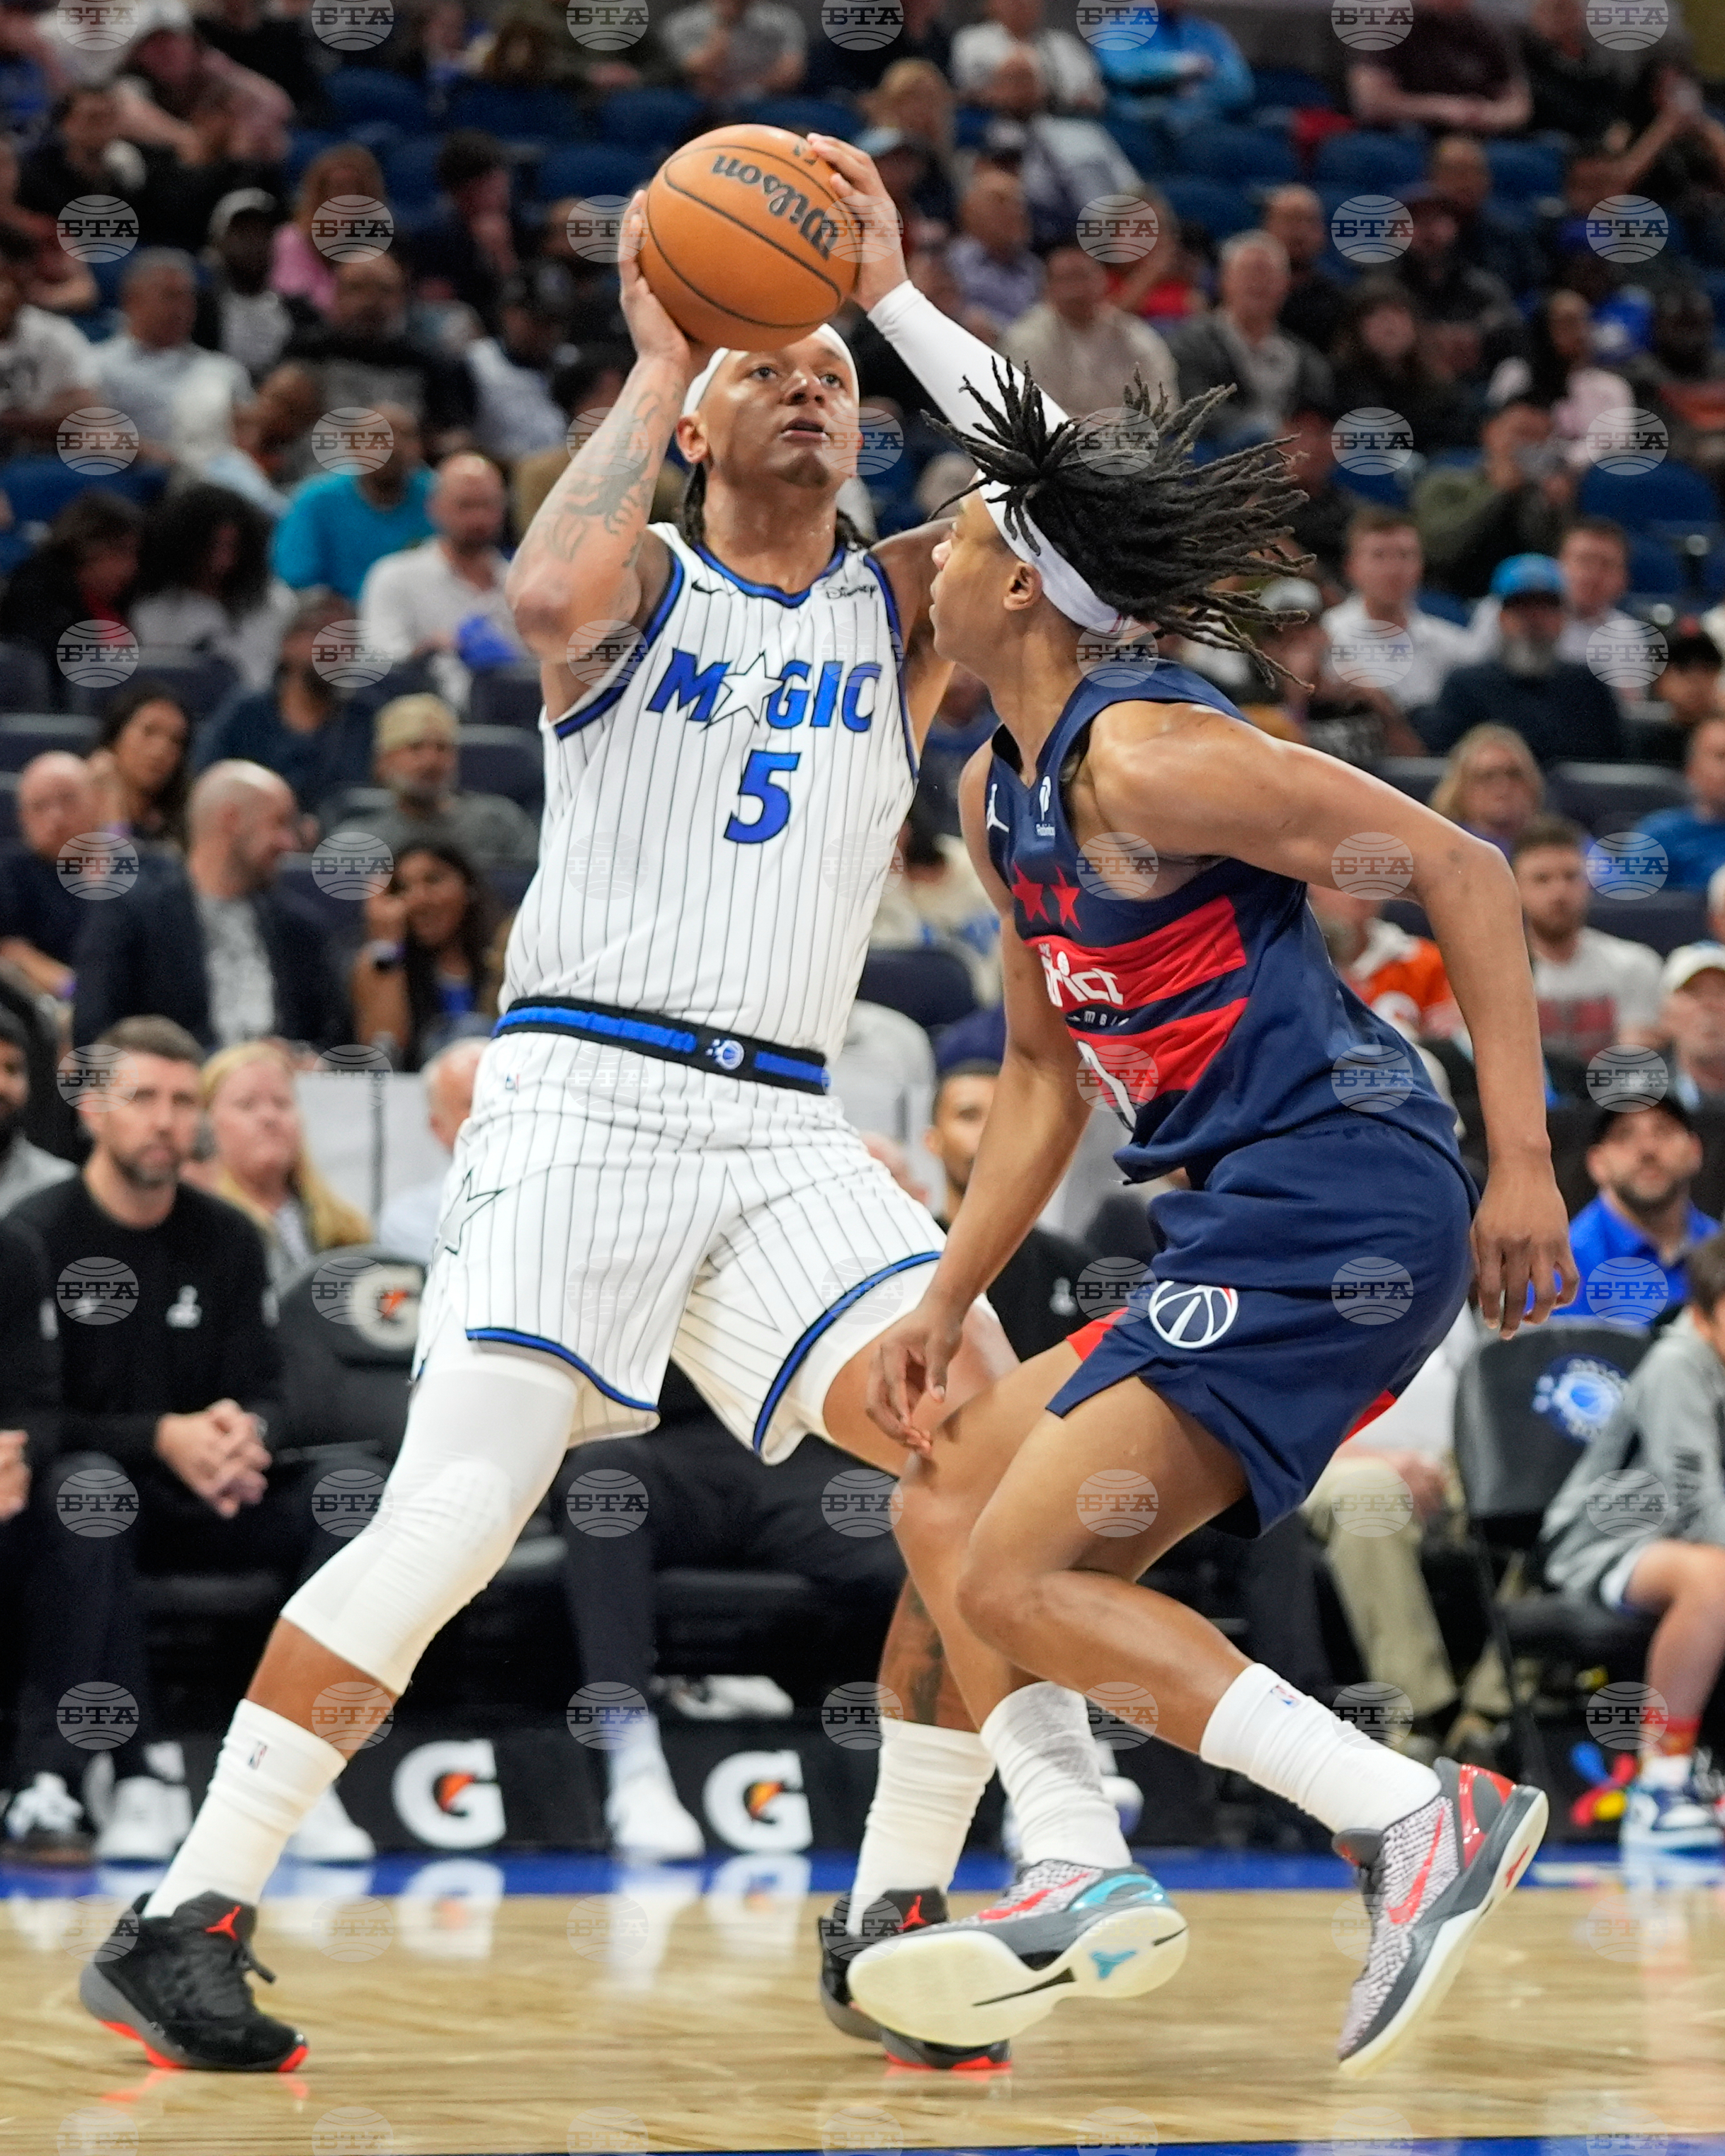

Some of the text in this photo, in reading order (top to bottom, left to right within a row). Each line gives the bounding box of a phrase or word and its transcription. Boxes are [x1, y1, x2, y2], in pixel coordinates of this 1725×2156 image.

[711, 154, 839, 261] Wilson
[723, 749, 802, 844] 5
[392, 1739, 507, 1849] G
[702, 1750, 814, 1852] G
